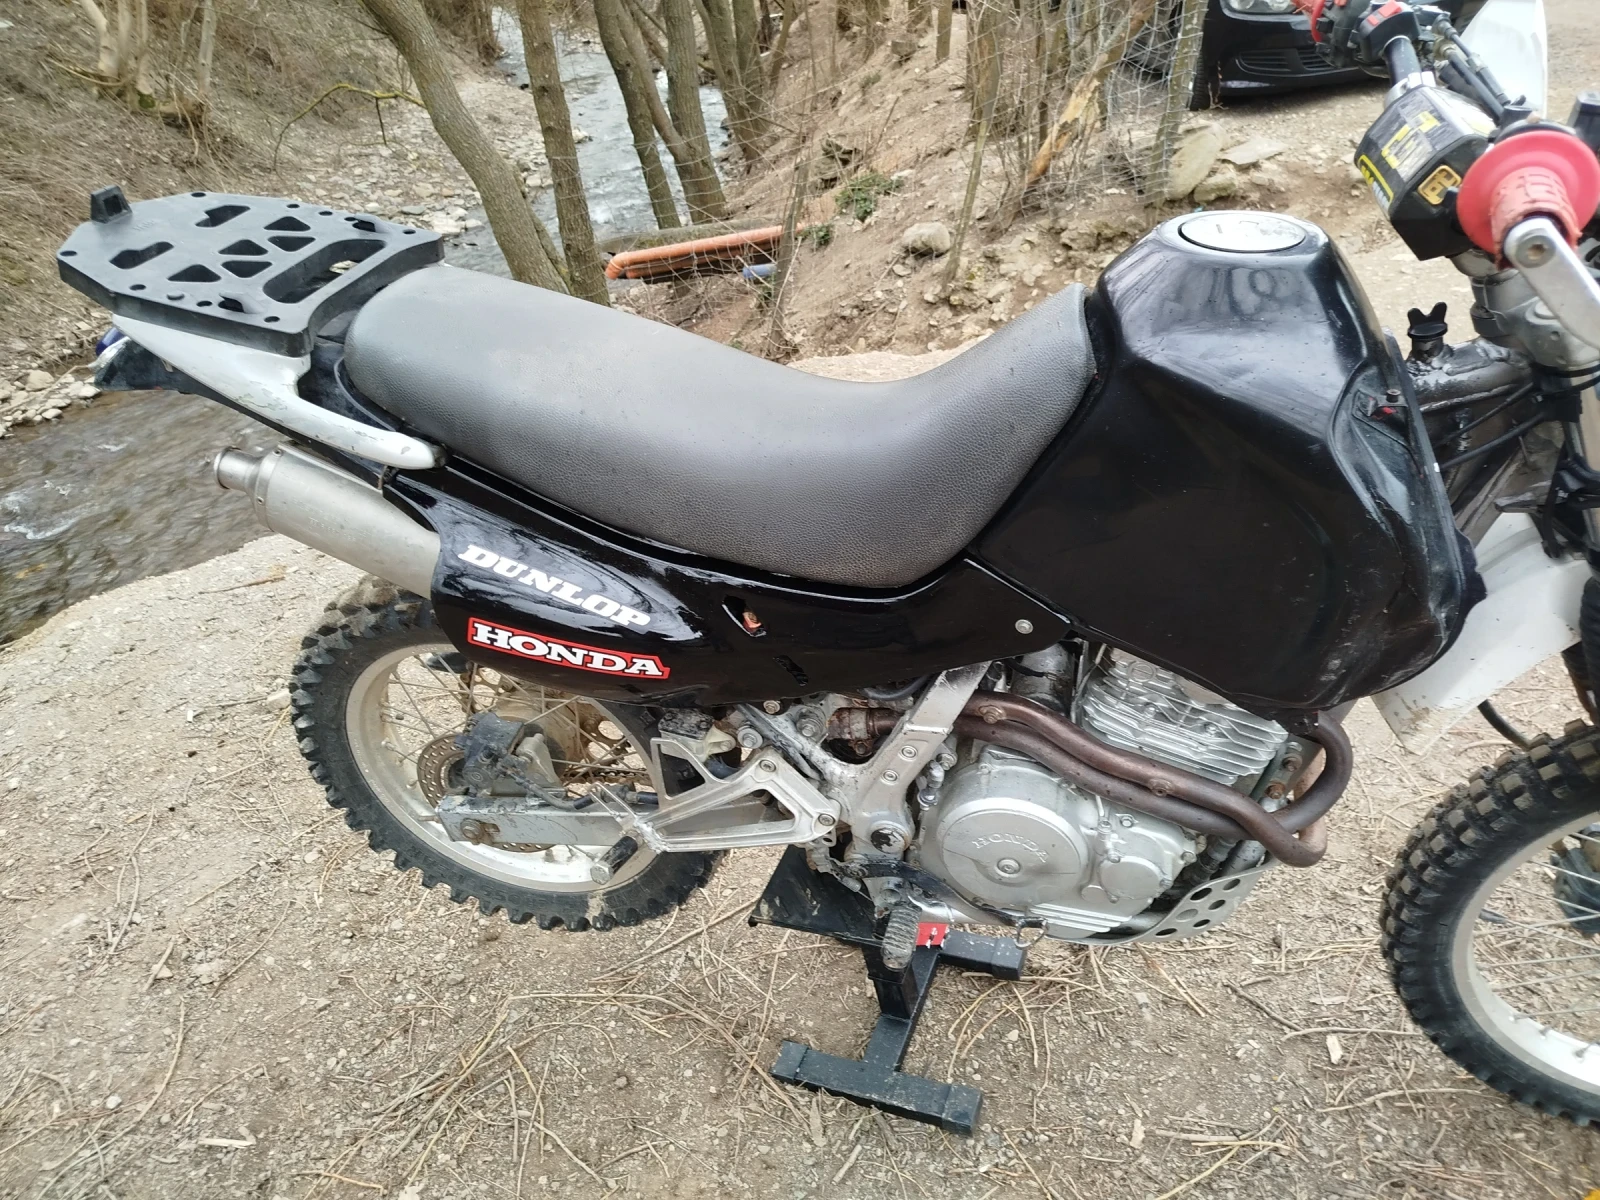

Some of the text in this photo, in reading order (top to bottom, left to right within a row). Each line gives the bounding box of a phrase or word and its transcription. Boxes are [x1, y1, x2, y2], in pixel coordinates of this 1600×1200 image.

[457, 544, 651, 626] DUNLOP
[473, 622, 663, 676] HONDA
[971, 832, 1048, 863] HONDA
